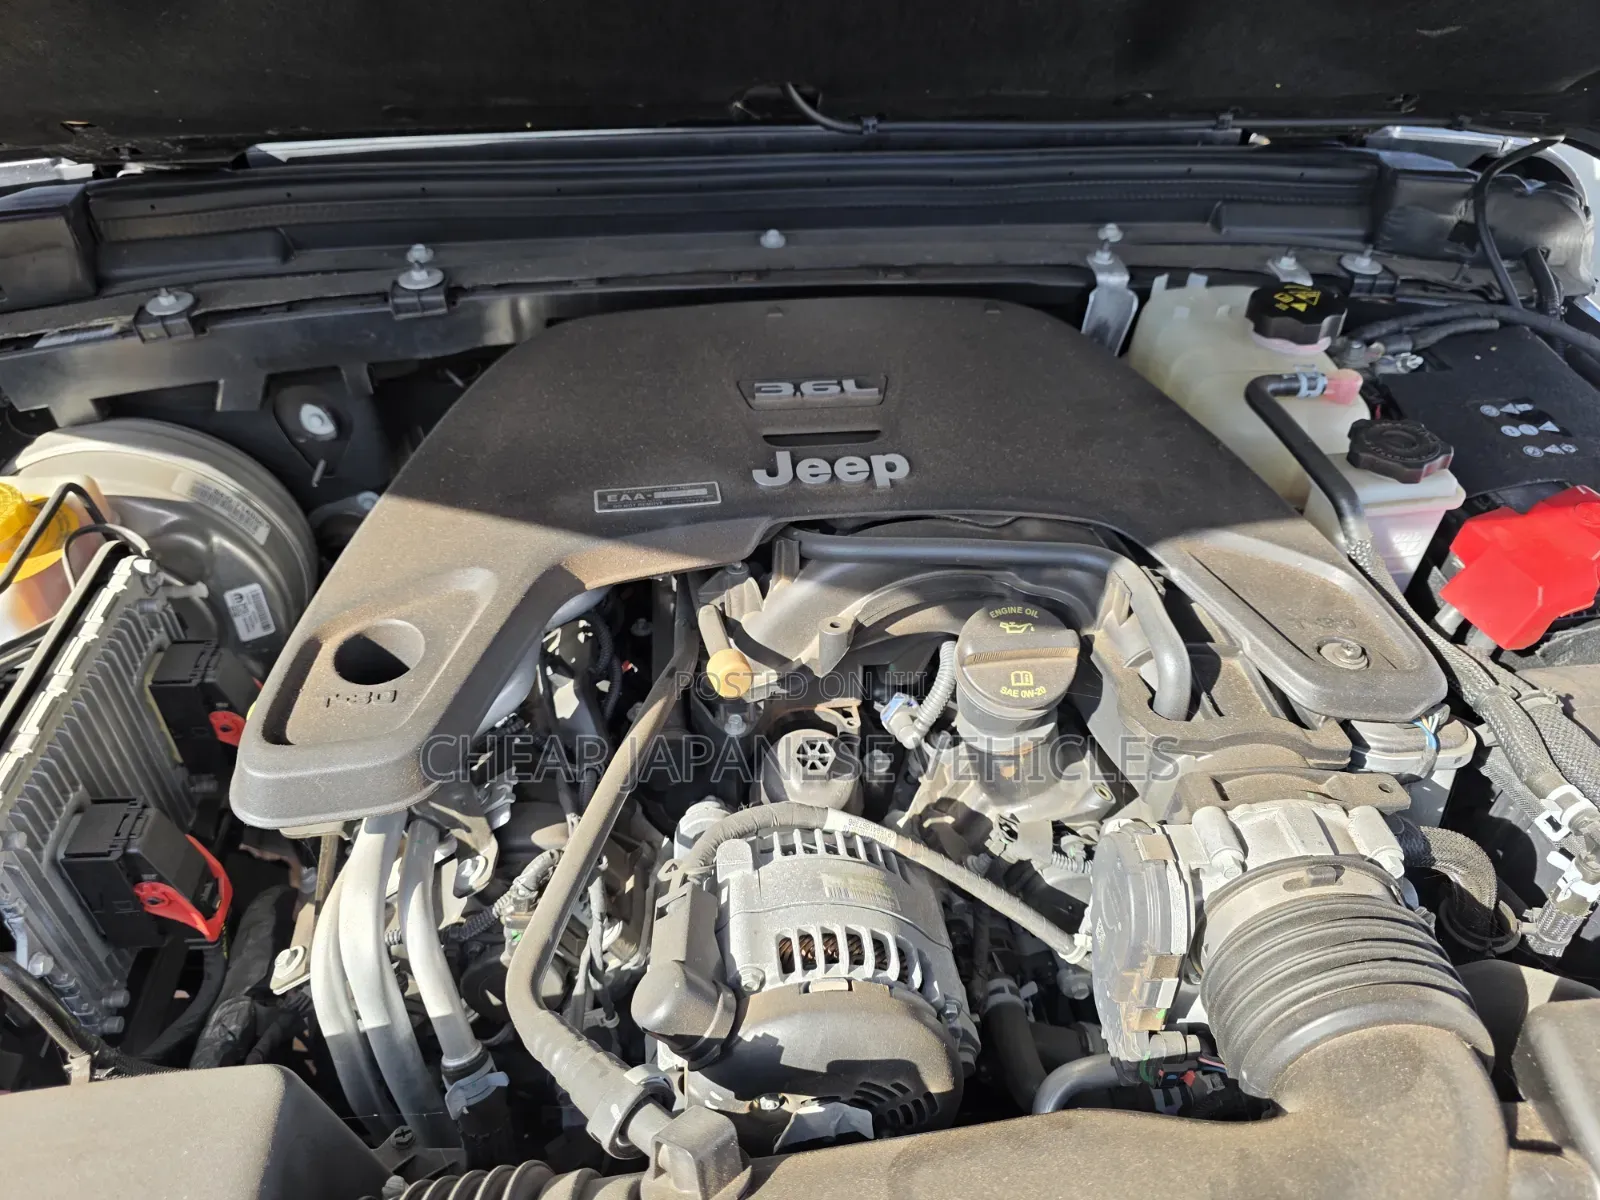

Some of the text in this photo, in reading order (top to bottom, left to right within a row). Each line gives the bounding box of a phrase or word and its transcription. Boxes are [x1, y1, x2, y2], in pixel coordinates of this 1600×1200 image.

[754, 378, 879, 398] 3.6L
[752, 450, 910, 489] Jeep
[989, 606, 1040, 619] ENGINE OIL
[1000, 685, 1047, 699] SAE 0W-20
